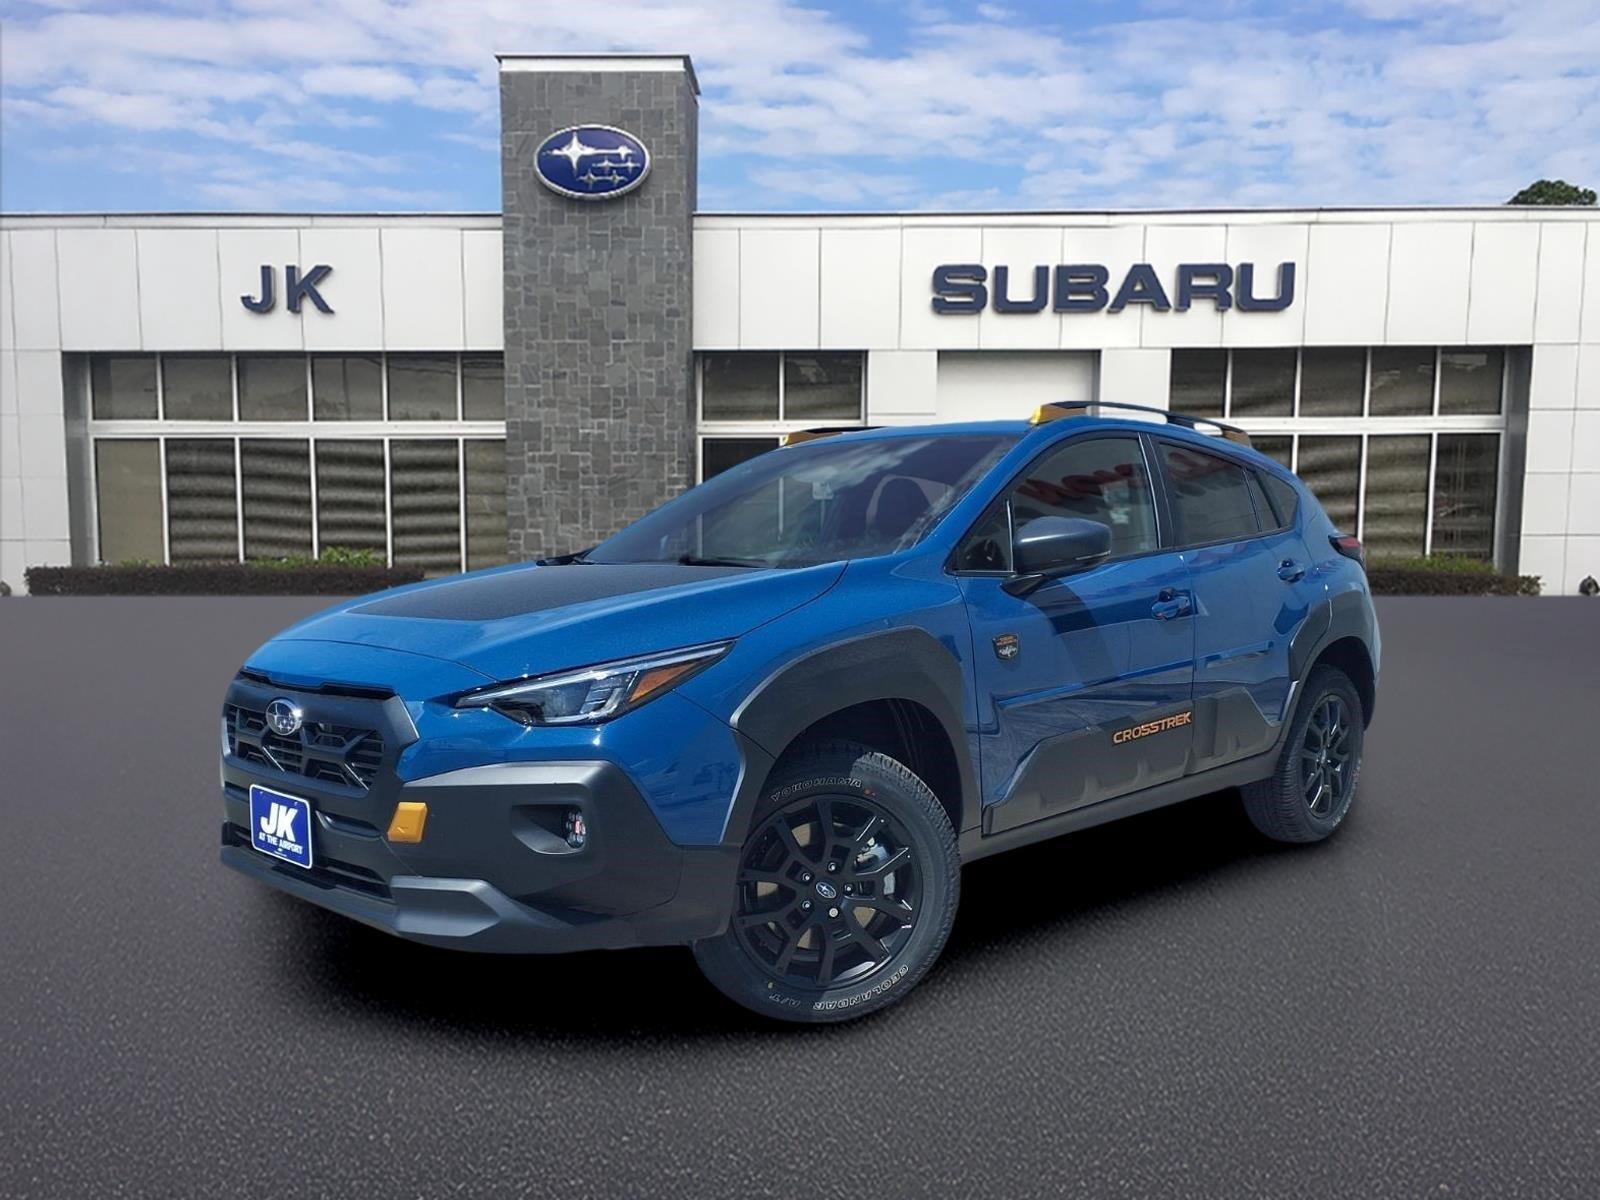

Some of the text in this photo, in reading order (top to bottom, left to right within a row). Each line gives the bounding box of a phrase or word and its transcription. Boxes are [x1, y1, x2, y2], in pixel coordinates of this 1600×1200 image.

[240, 264, 335, 314] JK
[931, 262, 1296, 314] SUBARU
[1112, 711, 1193, 745] CROSSTREK
[770, 777, 862, 802] YOKOHAMA
[260, 802, 298, 842] JK
[267, 834, 278, 846] THE
[279, 839, 303, 854] AIRPORT
[812, 964, 909, 1010] GEOLANDAR
